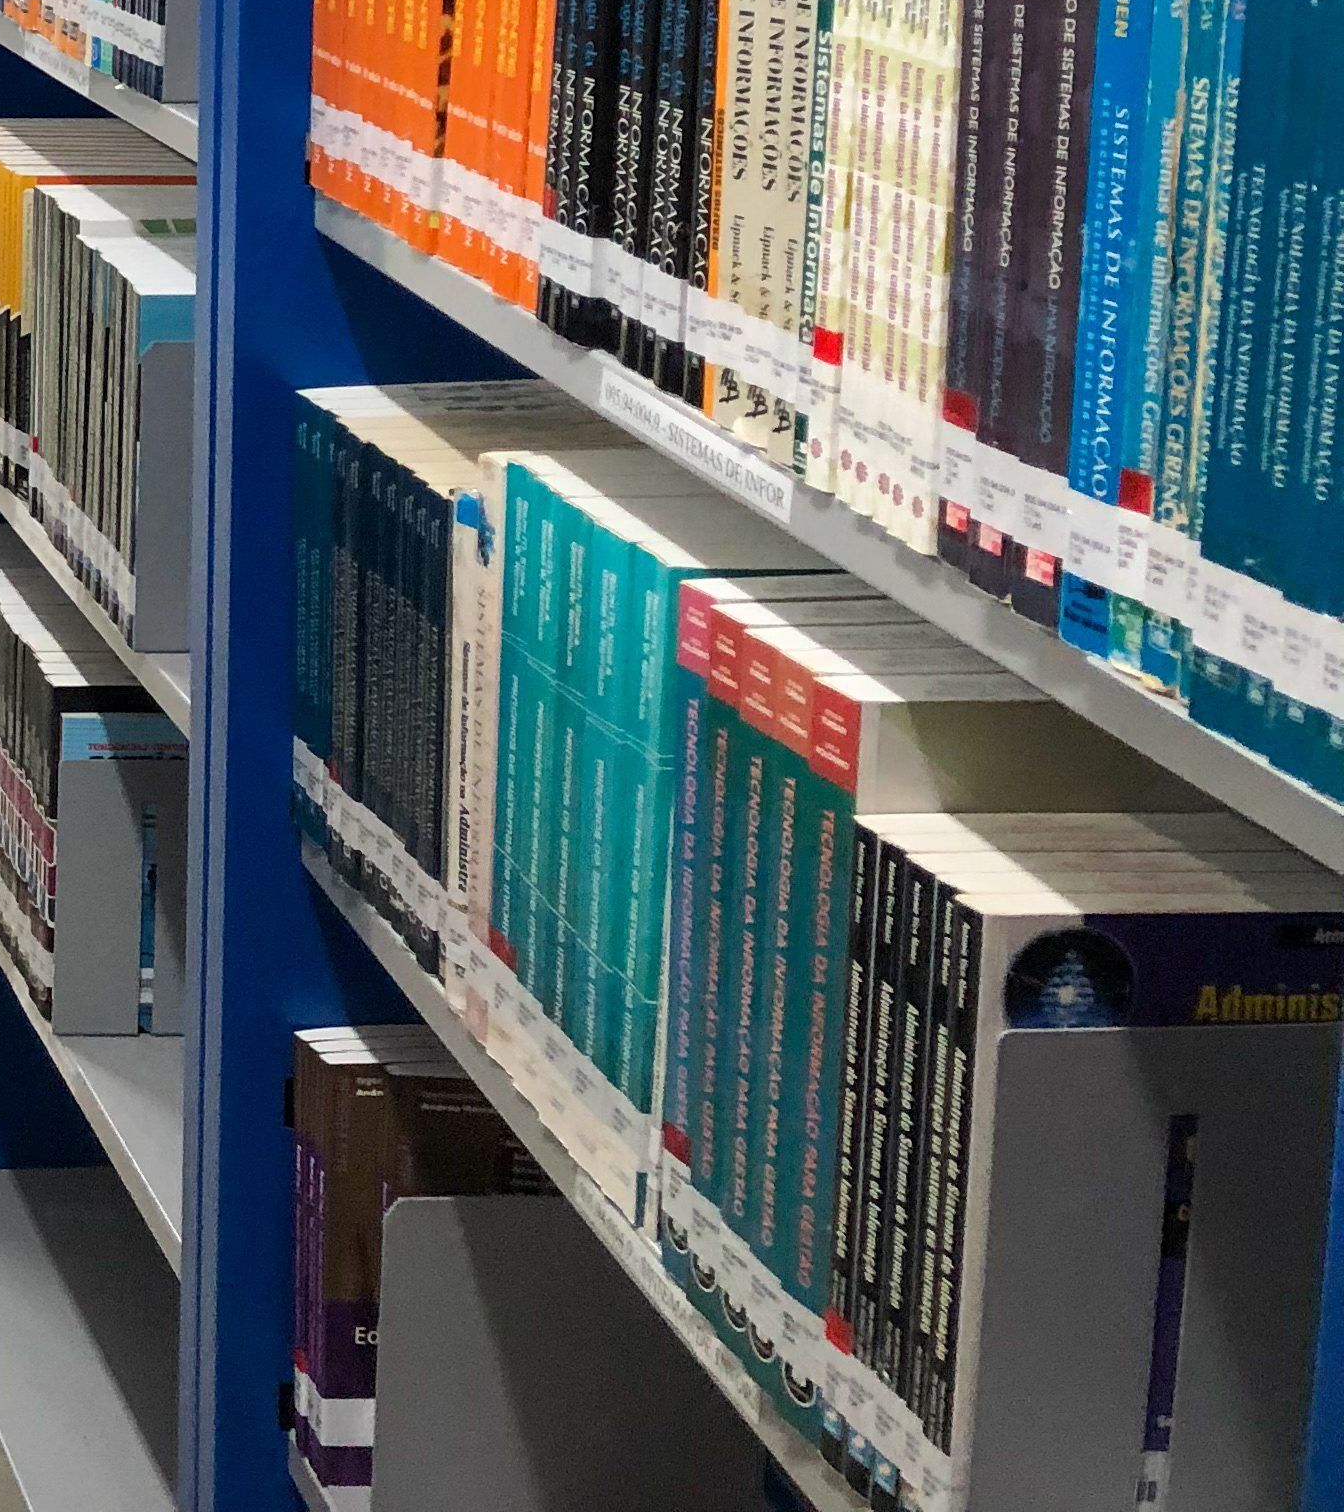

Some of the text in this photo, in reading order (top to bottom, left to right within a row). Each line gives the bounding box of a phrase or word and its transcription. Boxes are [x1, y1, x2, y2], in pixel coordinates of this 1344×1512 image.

[1012, 5, 1026, 28] DE
[1061, 19, 1077, 43] DE
[810, 30, 833, 151] Sistemas
[1007, 34, 1025, 113] SISTEMAS
[1057, 48, 1076, 131] SISTEMAS
[1006, 119, 1020, 142] DE
[1055, 135, 1070, 158] DE
[1184, 77, 1211, 190] SISTEMAS
[809, 162, 827, 194] de
[1046, 166, 1069, 289] INFORMAÇÃO
[1181, 199, 1204, 231] DE
[1089, 106, 1132, 497] SISTEMAS DE INFORMAÇÃO
[668, 422, 723, 473] SISTEMAS
[726, 460, 742, 480] DE
[813, 809, 835, 946] TECNOLOGIA
[812, 955, 827, 983] DA
[801, 1145, 819, 1197] PARA
